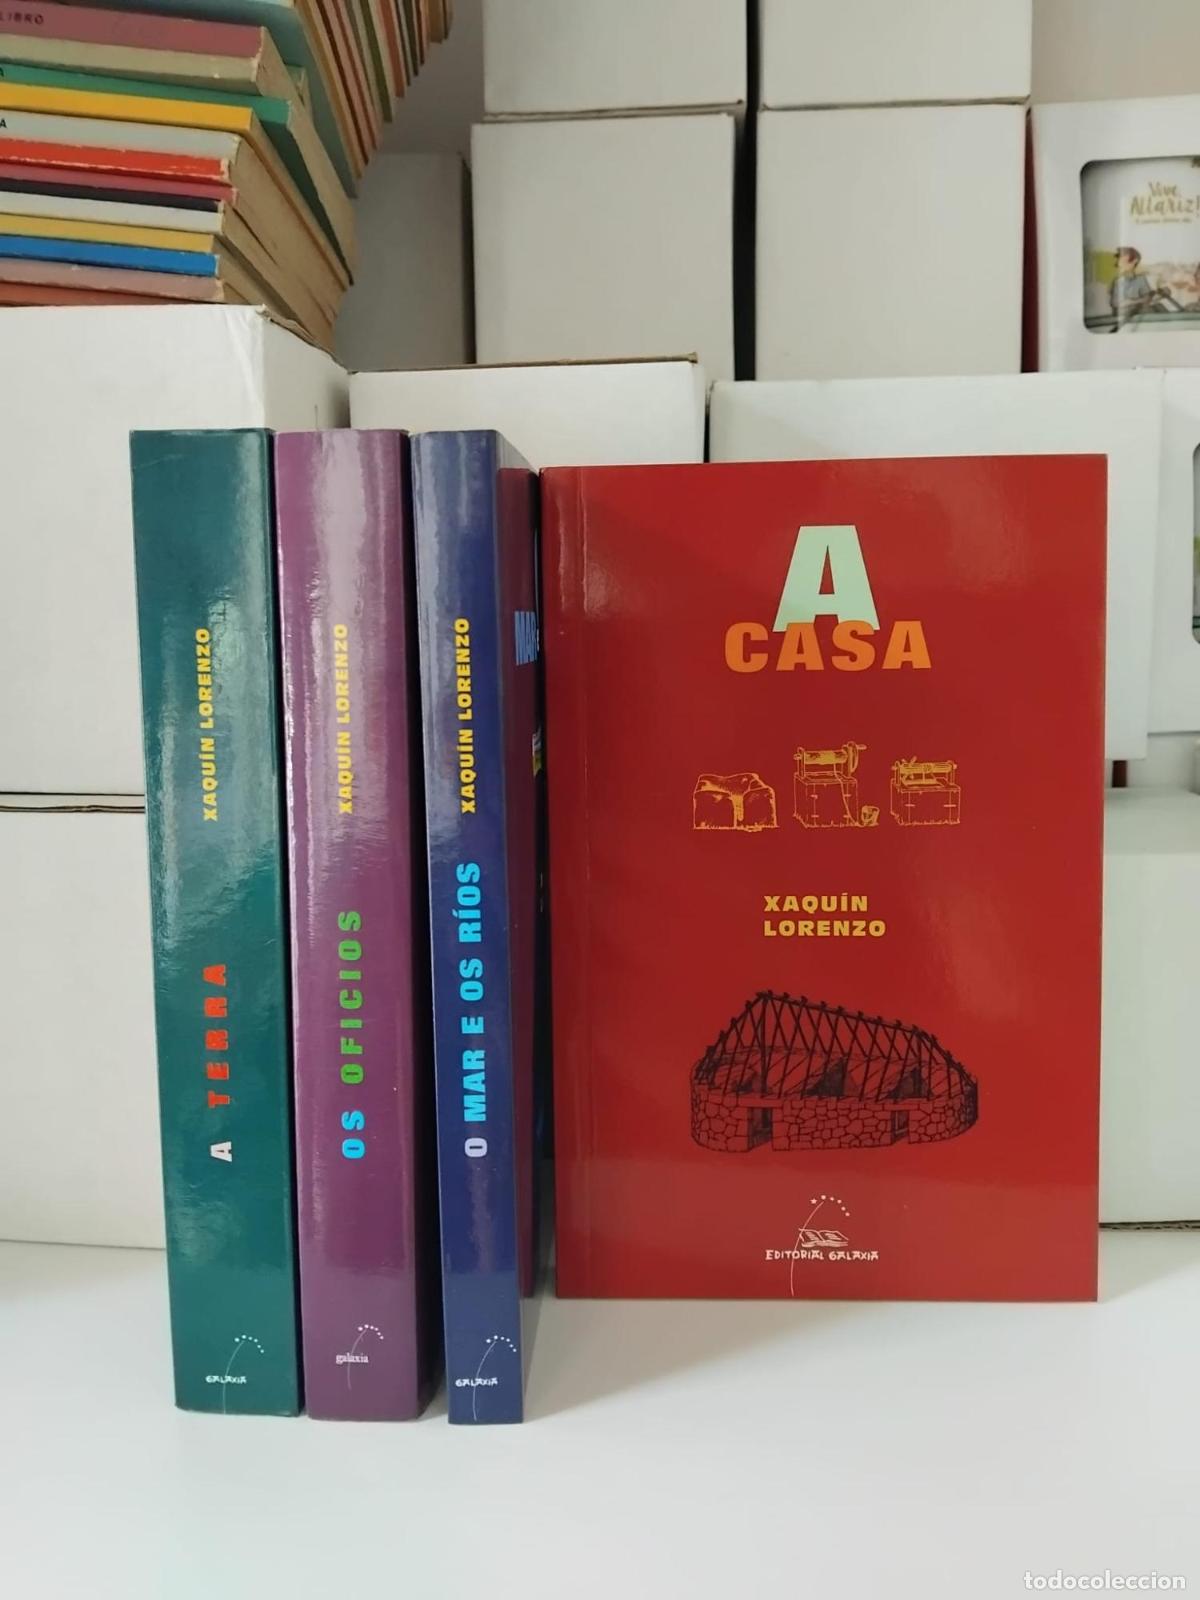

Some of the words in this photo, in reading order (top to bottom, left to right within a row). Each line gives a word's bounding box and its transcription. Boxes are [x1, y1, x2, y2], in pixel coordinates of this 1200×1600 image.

[773, 525, 880, 632] A
[454, 618, 472, 720] LORENZO
[724, 620, 932, 673] CASA
[195, 628, 214, 729] LORENZO
[333, 623, 350, 724] LORENZO
[201, 737, 218, 822] XAQUÍN
[335, 731, 353, 815] XAQUÍN
[457, 729, 476, 814] XAQUÍN
[452, 862, 482, 943] RÍOS
[764, 892, 868, 915] XAQUÍN
[764, 920, 886, 937] LORENZO
[338, 910, 364, 1084] OFICIOS
[459, 958, 484, 1001] OS
[203, 964, 231, 1108] TERRA
[461, 1016, 484, 1034] E
[462, 1050, 487, 1122] MAR
[210, 1141, 233, 1162] A
[341, 1110, 366, 1159] OS
[464, 1137, 488, 1158] O
[765, 1249, 824, 1260] EDITORIAL
[828, 1250, 879, 1261] GALAXIA
[205, 1374, 248, 1385] GALAXIA
[335, 1352, 369, 1365] galaxia
[455, 1376, 498, 1388] GALAXIA
